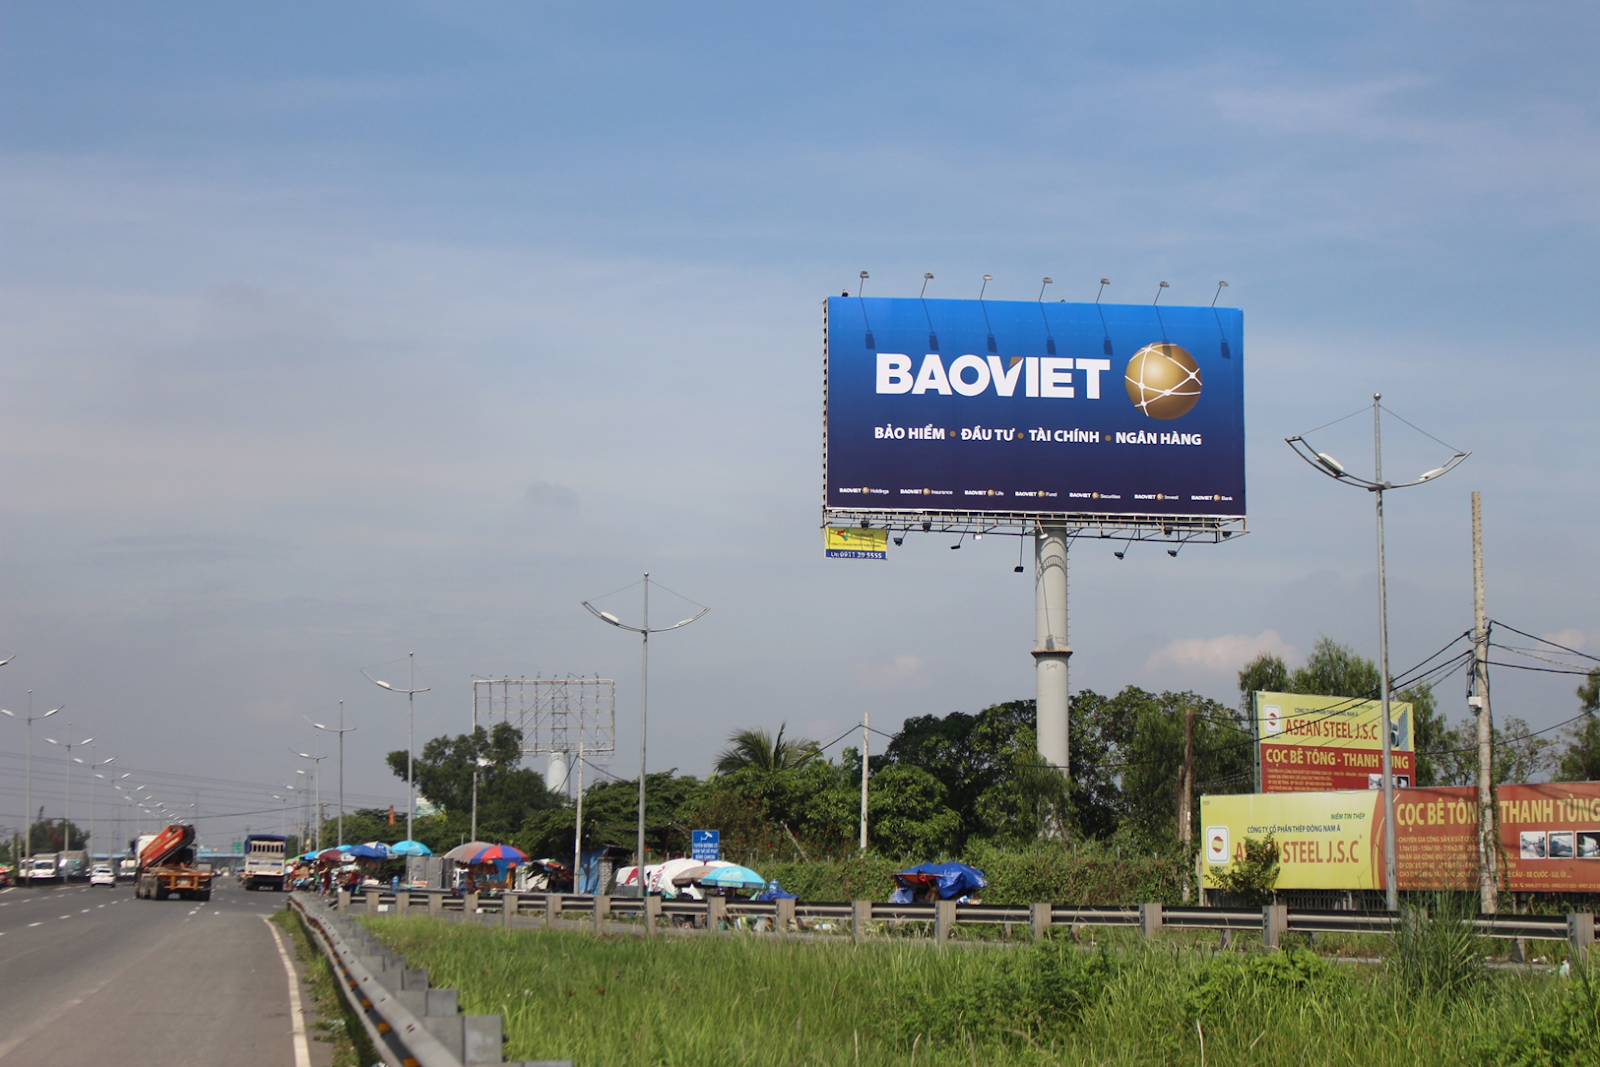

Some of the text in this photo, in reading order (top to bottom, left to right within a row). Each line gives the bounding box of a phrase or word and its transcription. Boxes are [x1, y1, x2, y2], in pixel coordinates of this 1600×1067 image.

[875, 352, 1111, 399] BAOVIET
[874, 423, 1202, 446] BẢO HIỂM ĐẦU TƯ TÀI CHÍNH NGÂN HÀNG
[1285, 719, 1378, 740] ASEAN STEEL J.S.C
[1266, 748, 1288, 767] CỌC
[1290, 747, 1304, 764] BÊ
[1305, 748, 1336, 766] TÔNG
[1342, 752, 1379, 767] THANH
[1397, 793, 1600, 832] CỌC BÊ TÔN THANH TÙNG
[1247, 825, 1261, 833] CÔNG
[1293, 825, 1306, 833] THÉP
[1306, 824, 1322, 833] ĐÔNG
[1283, 840, 1323, 863] STEEL
[1326, 840, 1359, 863] J.S.C
